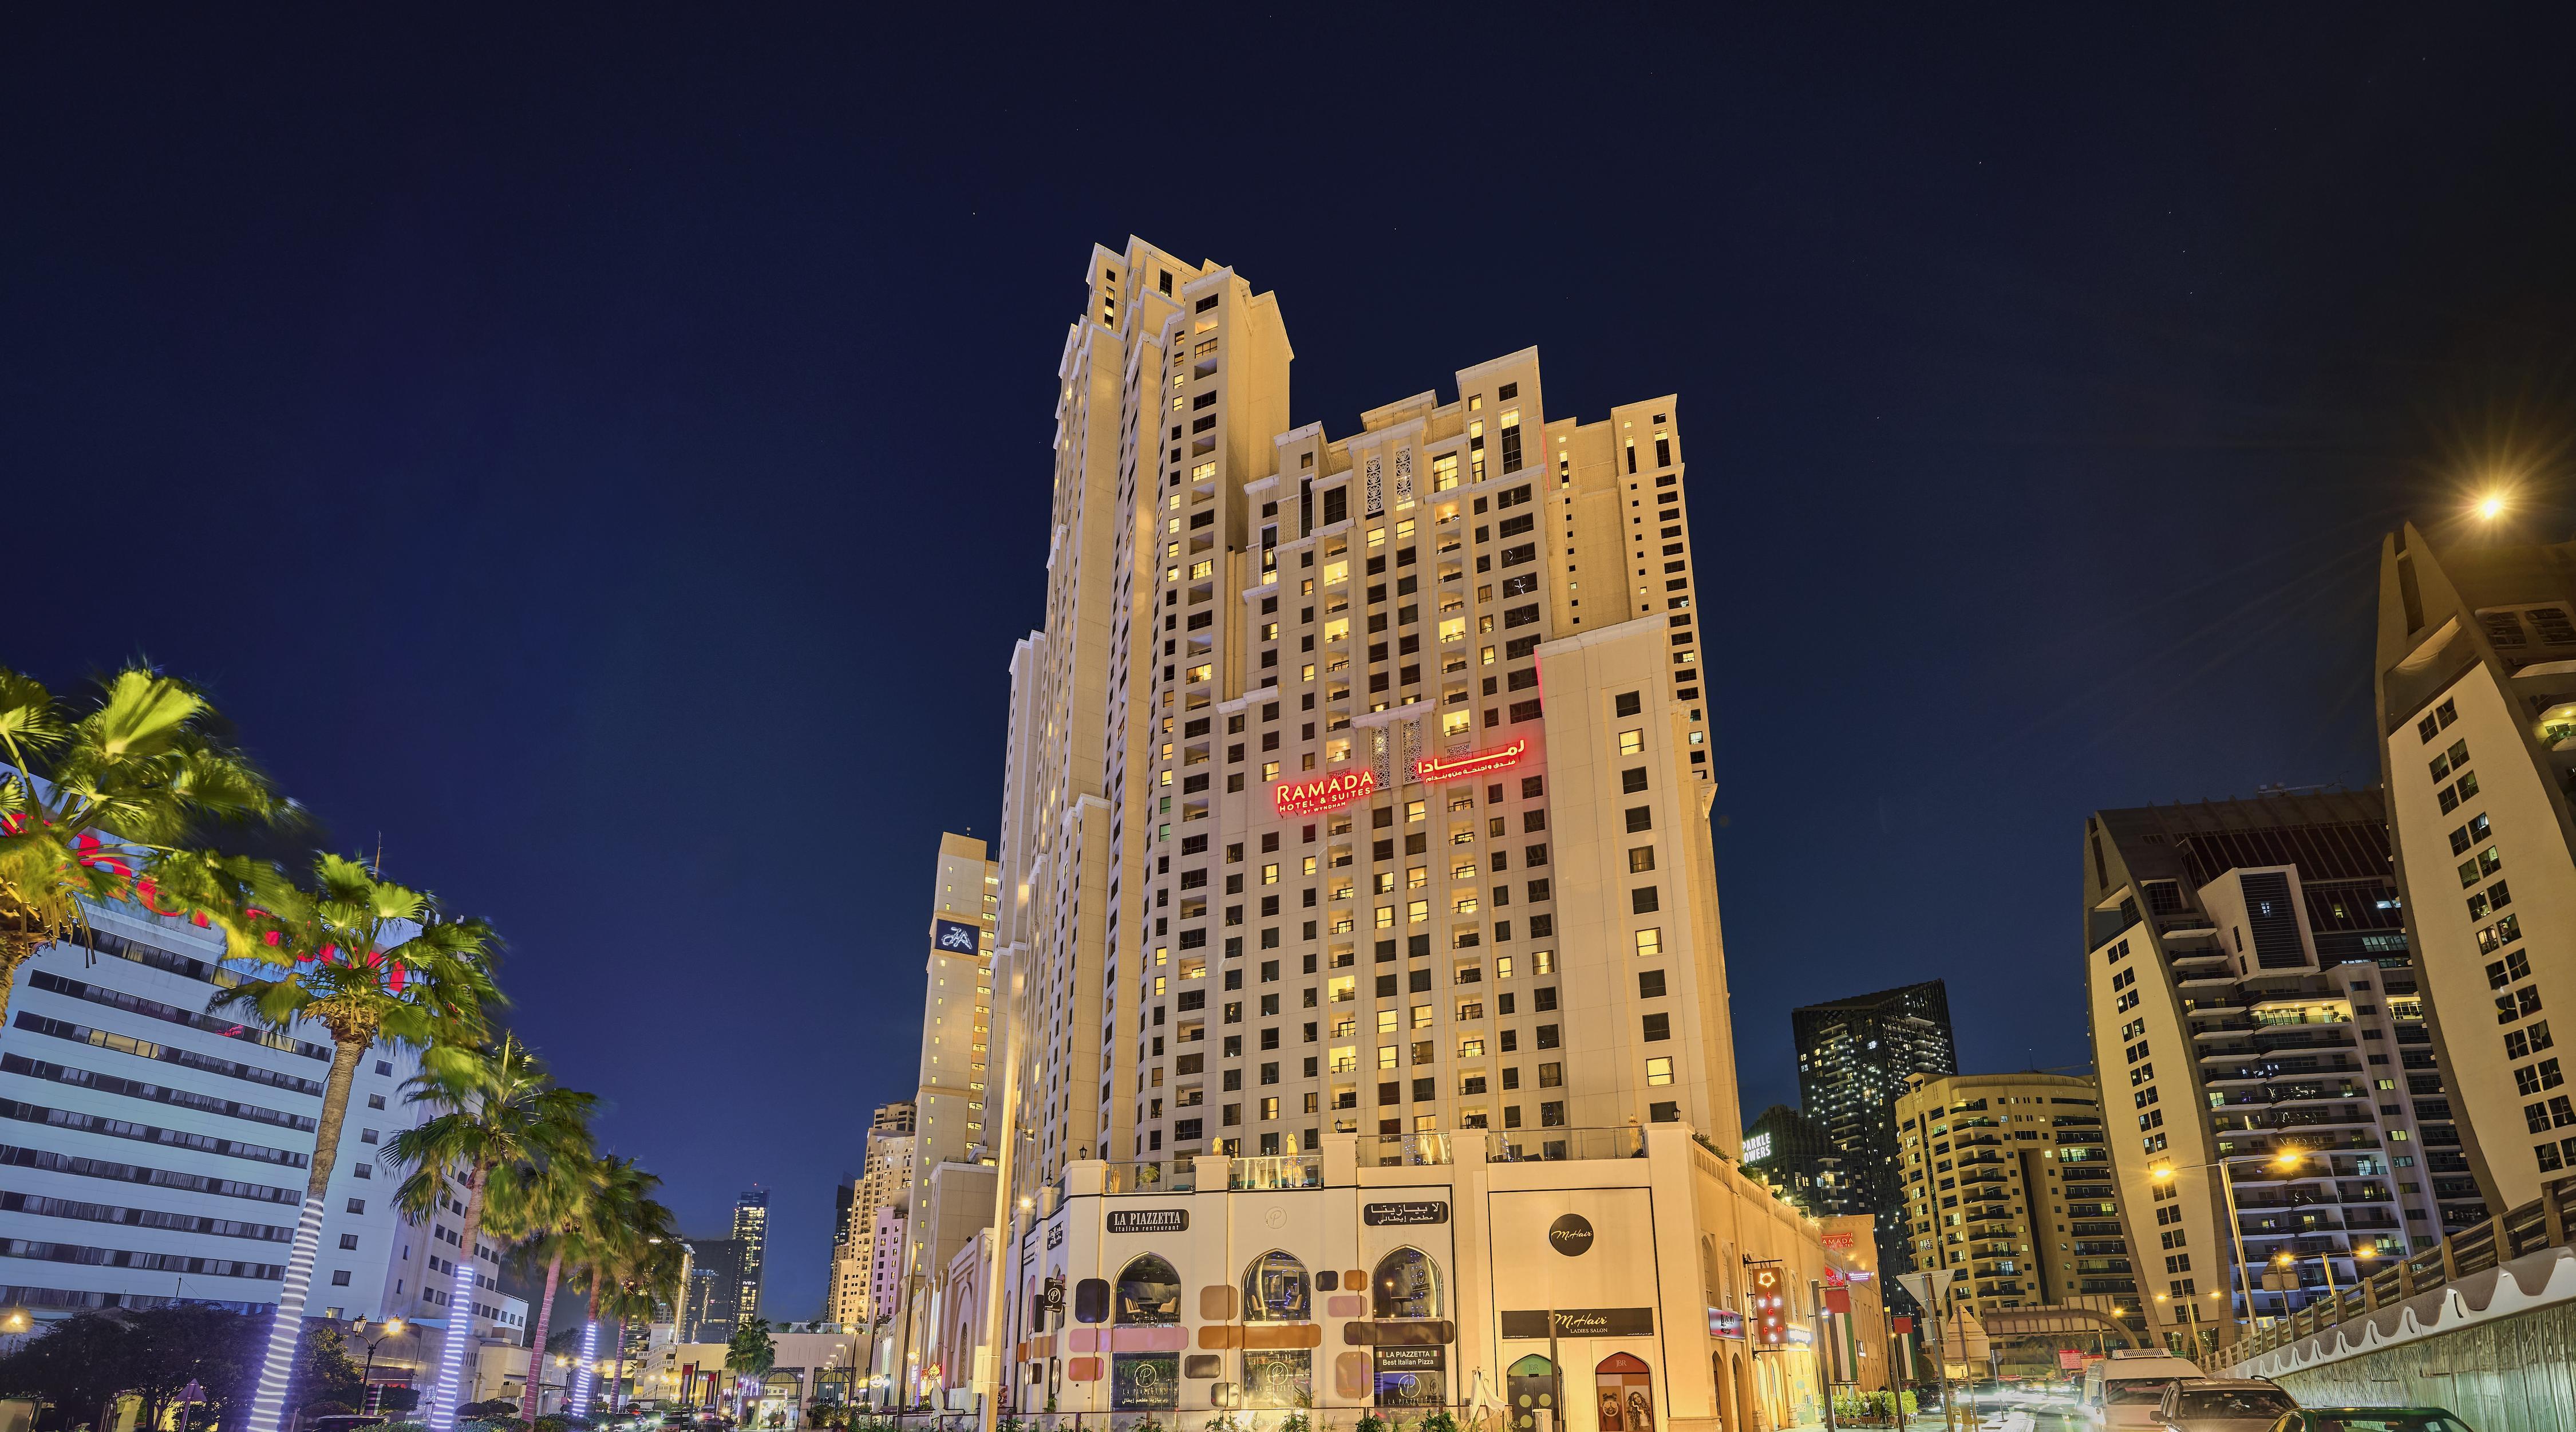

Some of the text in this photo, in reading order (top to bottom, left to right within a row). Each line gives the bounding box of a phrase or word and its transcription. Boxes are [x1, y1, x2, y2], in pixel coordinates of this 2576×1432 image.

[1418, 739, 1525, 774] رمادا
[1493, 759, 1516, 769] فندق
[1277, 771, 1373, 804] RAMADA
[1279, 800, 1314, 812] HOTEL
[1332, 787, 1370, 802] SUITES
[1314, 802, 1346, 812] WYNDHAM
[1743, 1133, 1771, 1152] PARKLE
[1744, 1145, 1771, 1163] OWERS
[1371, 1202, 1439, 1216] لا بيازيتا
[1114, 1212, 1180, 1225] LA PIAZZETTA
[1377, 1216, 1406, 1224] إيطالي
